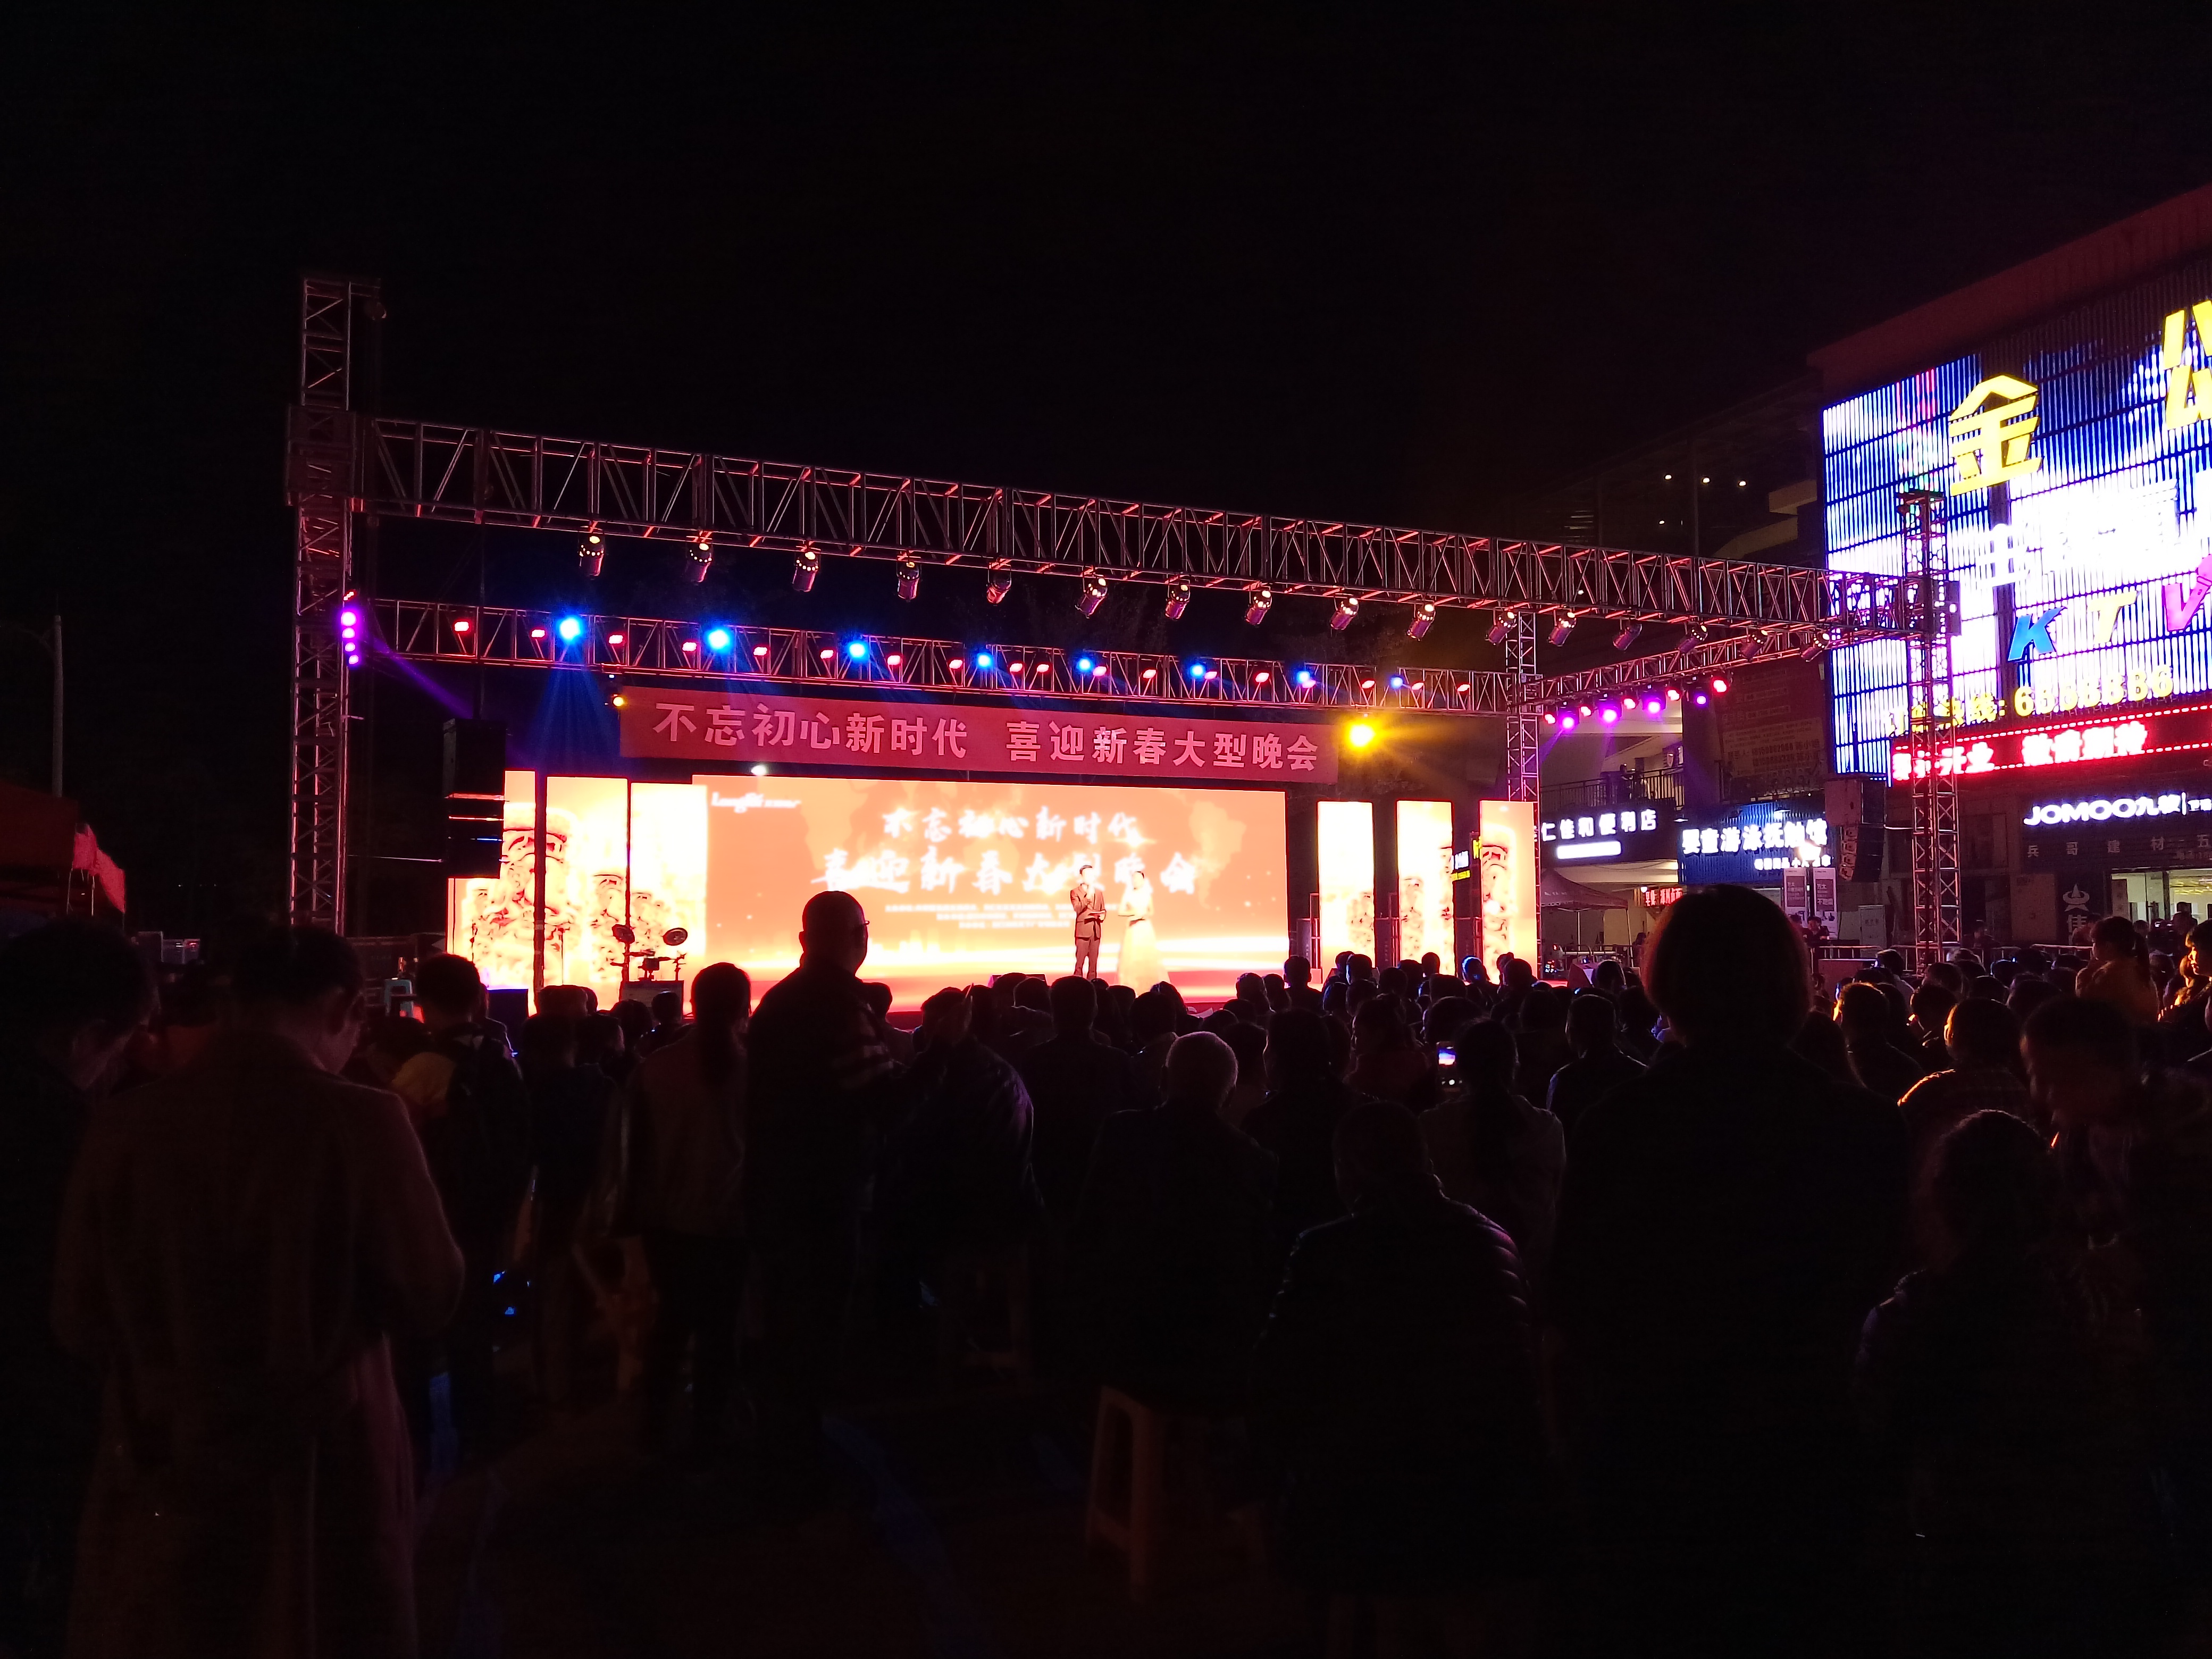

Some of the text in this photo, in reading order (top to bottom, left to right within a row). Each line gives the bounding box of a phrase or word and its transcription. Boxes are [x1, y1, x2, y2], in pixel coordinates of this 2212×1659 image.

[652, 702, 1319, 772] 不忘初心新时代 喜迎新春大型晚会
